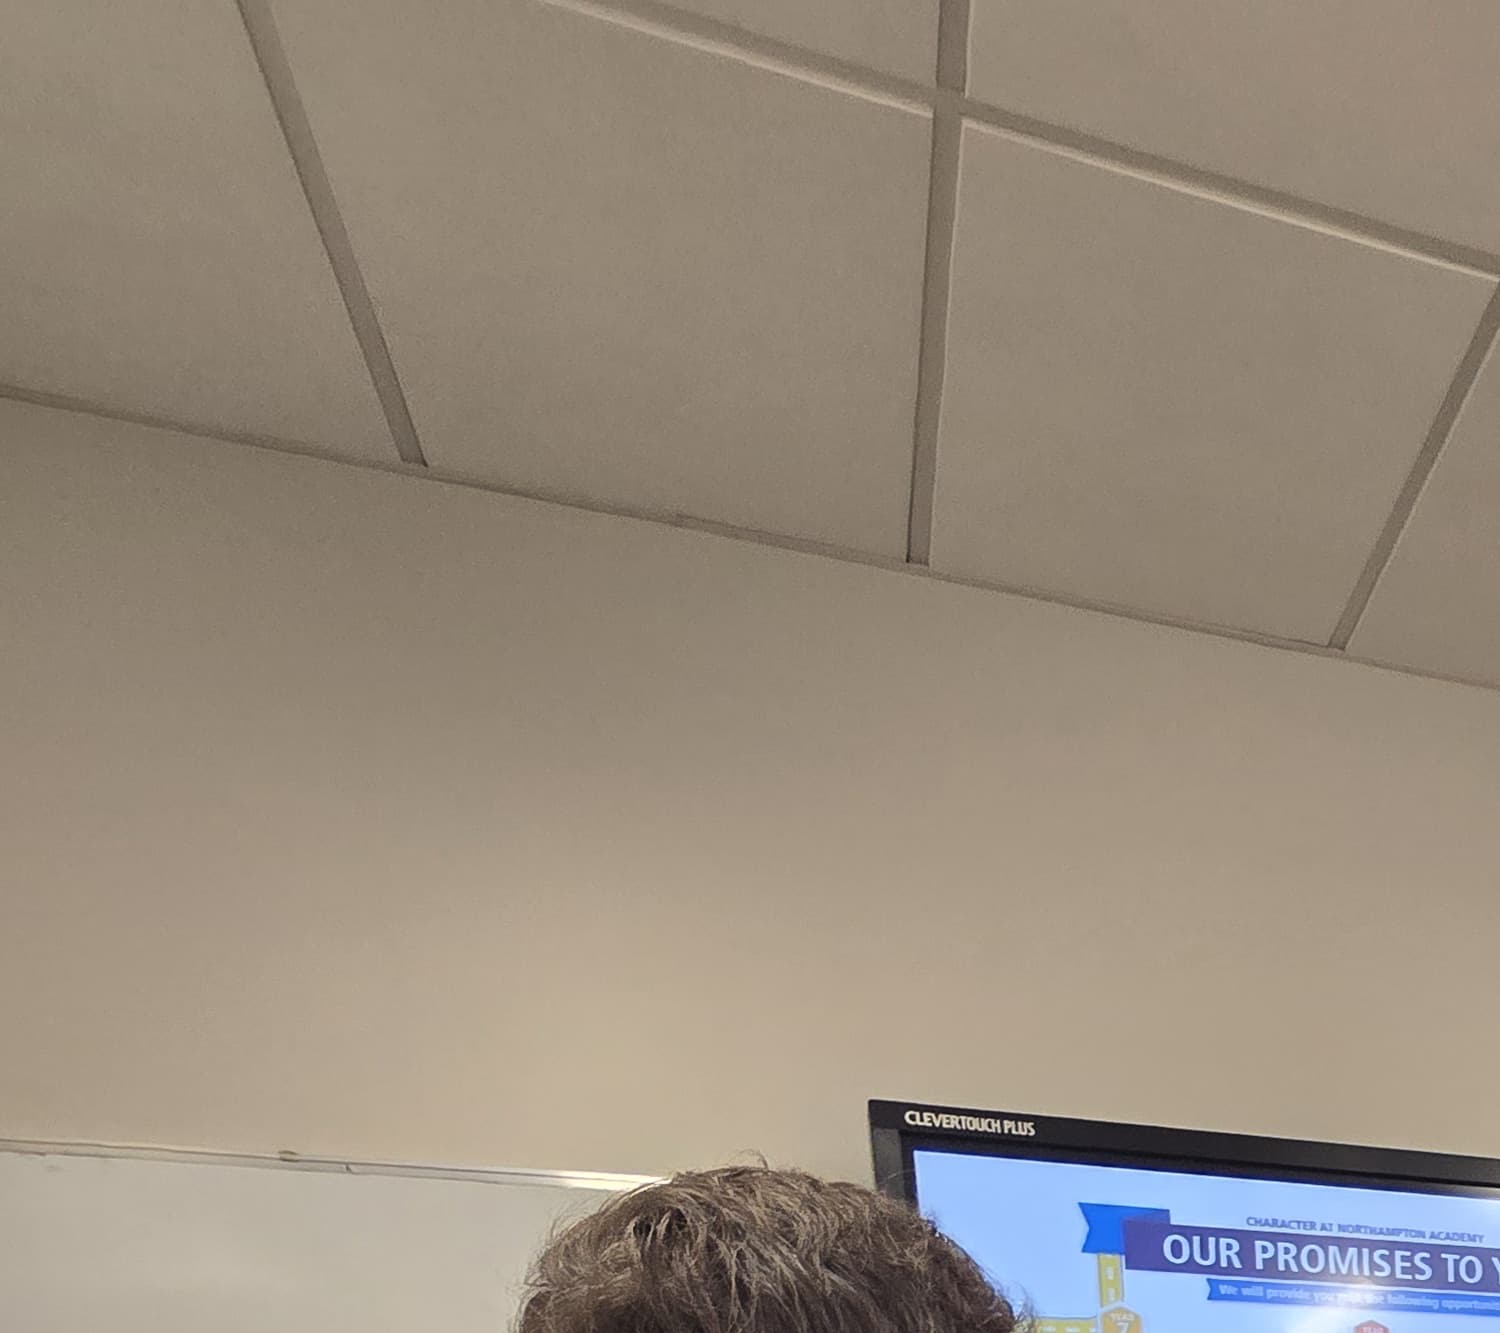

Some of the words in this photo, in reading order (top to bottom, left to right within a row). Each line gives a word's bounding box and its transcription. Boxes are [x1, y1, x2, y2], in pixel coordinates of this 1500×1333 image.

[903, 1110, 1001, 1133] CLEVERTOUCH
[1004, 1120, 1036, 1136] PLUS
[1247, 1217, 1317, 1231] CHARACTER
[1319, 1222, 1333, 1232] AT
[1338, 1223, 1425, 1238] NORTHAMPTON
[1429, 1229, 1484, 1243] ACADEMY
[1162, 1233, 1243, 1269] OUR
[1254, 1239, 1433, 1281] PROMISES
[1440, 1252, 1483, 1284] TO
[1218, 1283, 1239, 1296] We
[1241, 1285, 1264, 1298] will
[1266, 1286, 1310, 1303] provide
[1387, 1293, 1440, 1310] following
